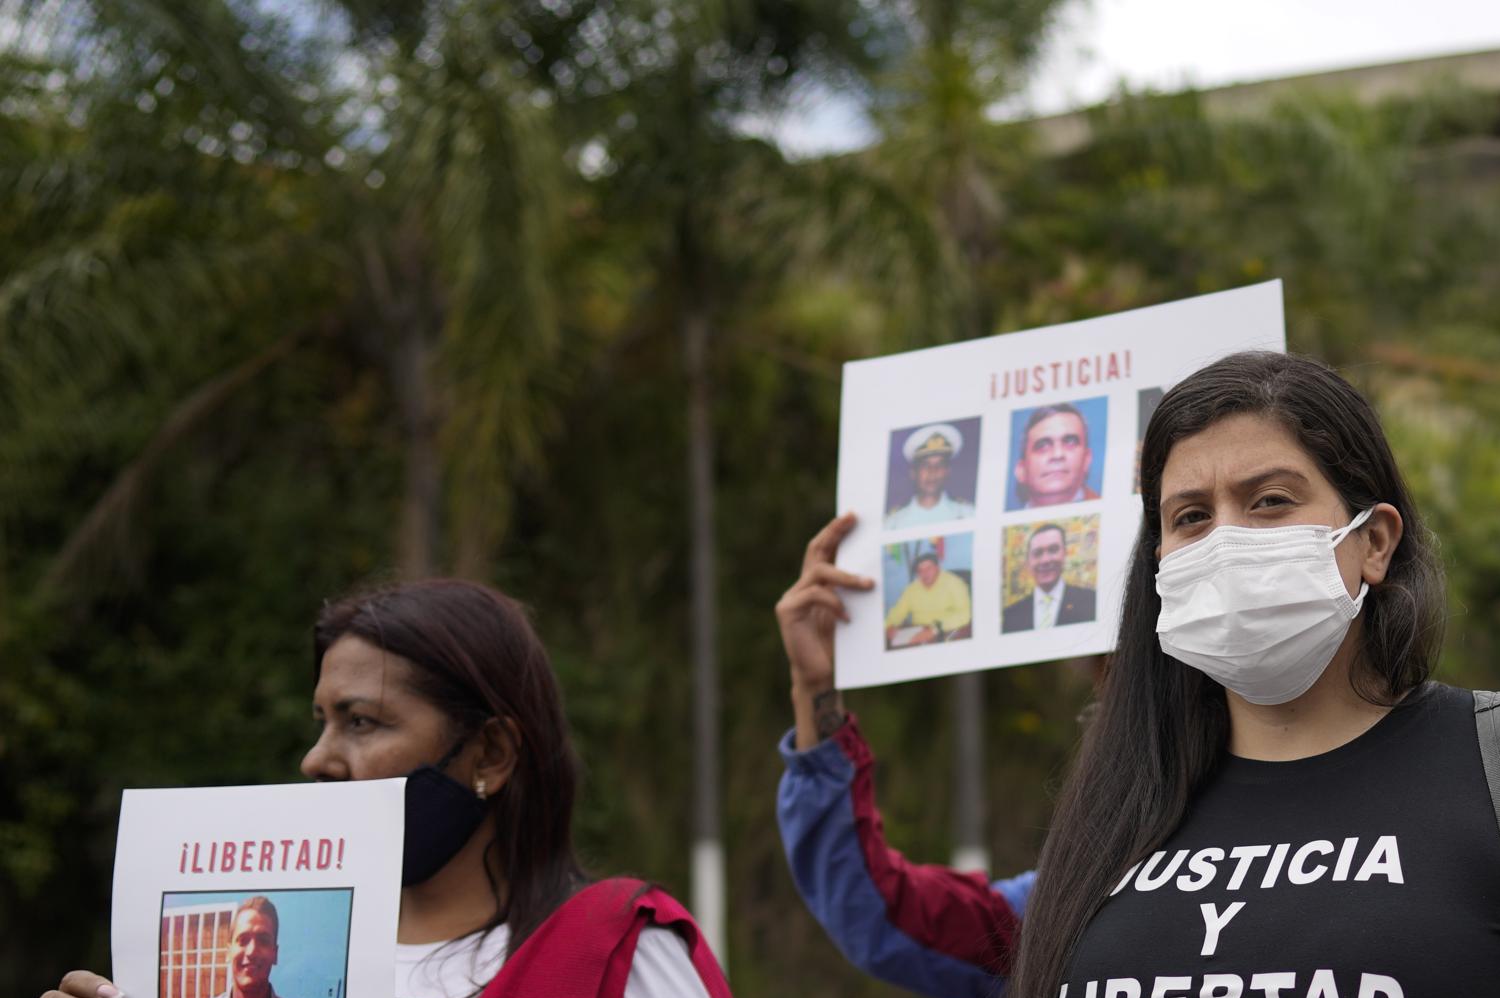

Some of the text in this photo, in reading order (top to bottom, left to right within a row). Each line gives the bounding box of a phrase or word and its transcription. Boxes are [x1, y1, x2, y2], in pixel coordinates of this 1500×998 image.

[990, 350, 1132, 400] ¡JUSTICIA!
[179, 838, 346, 874] ¡LIBERTAD!
[1199, 901, 1247, 956] Y
